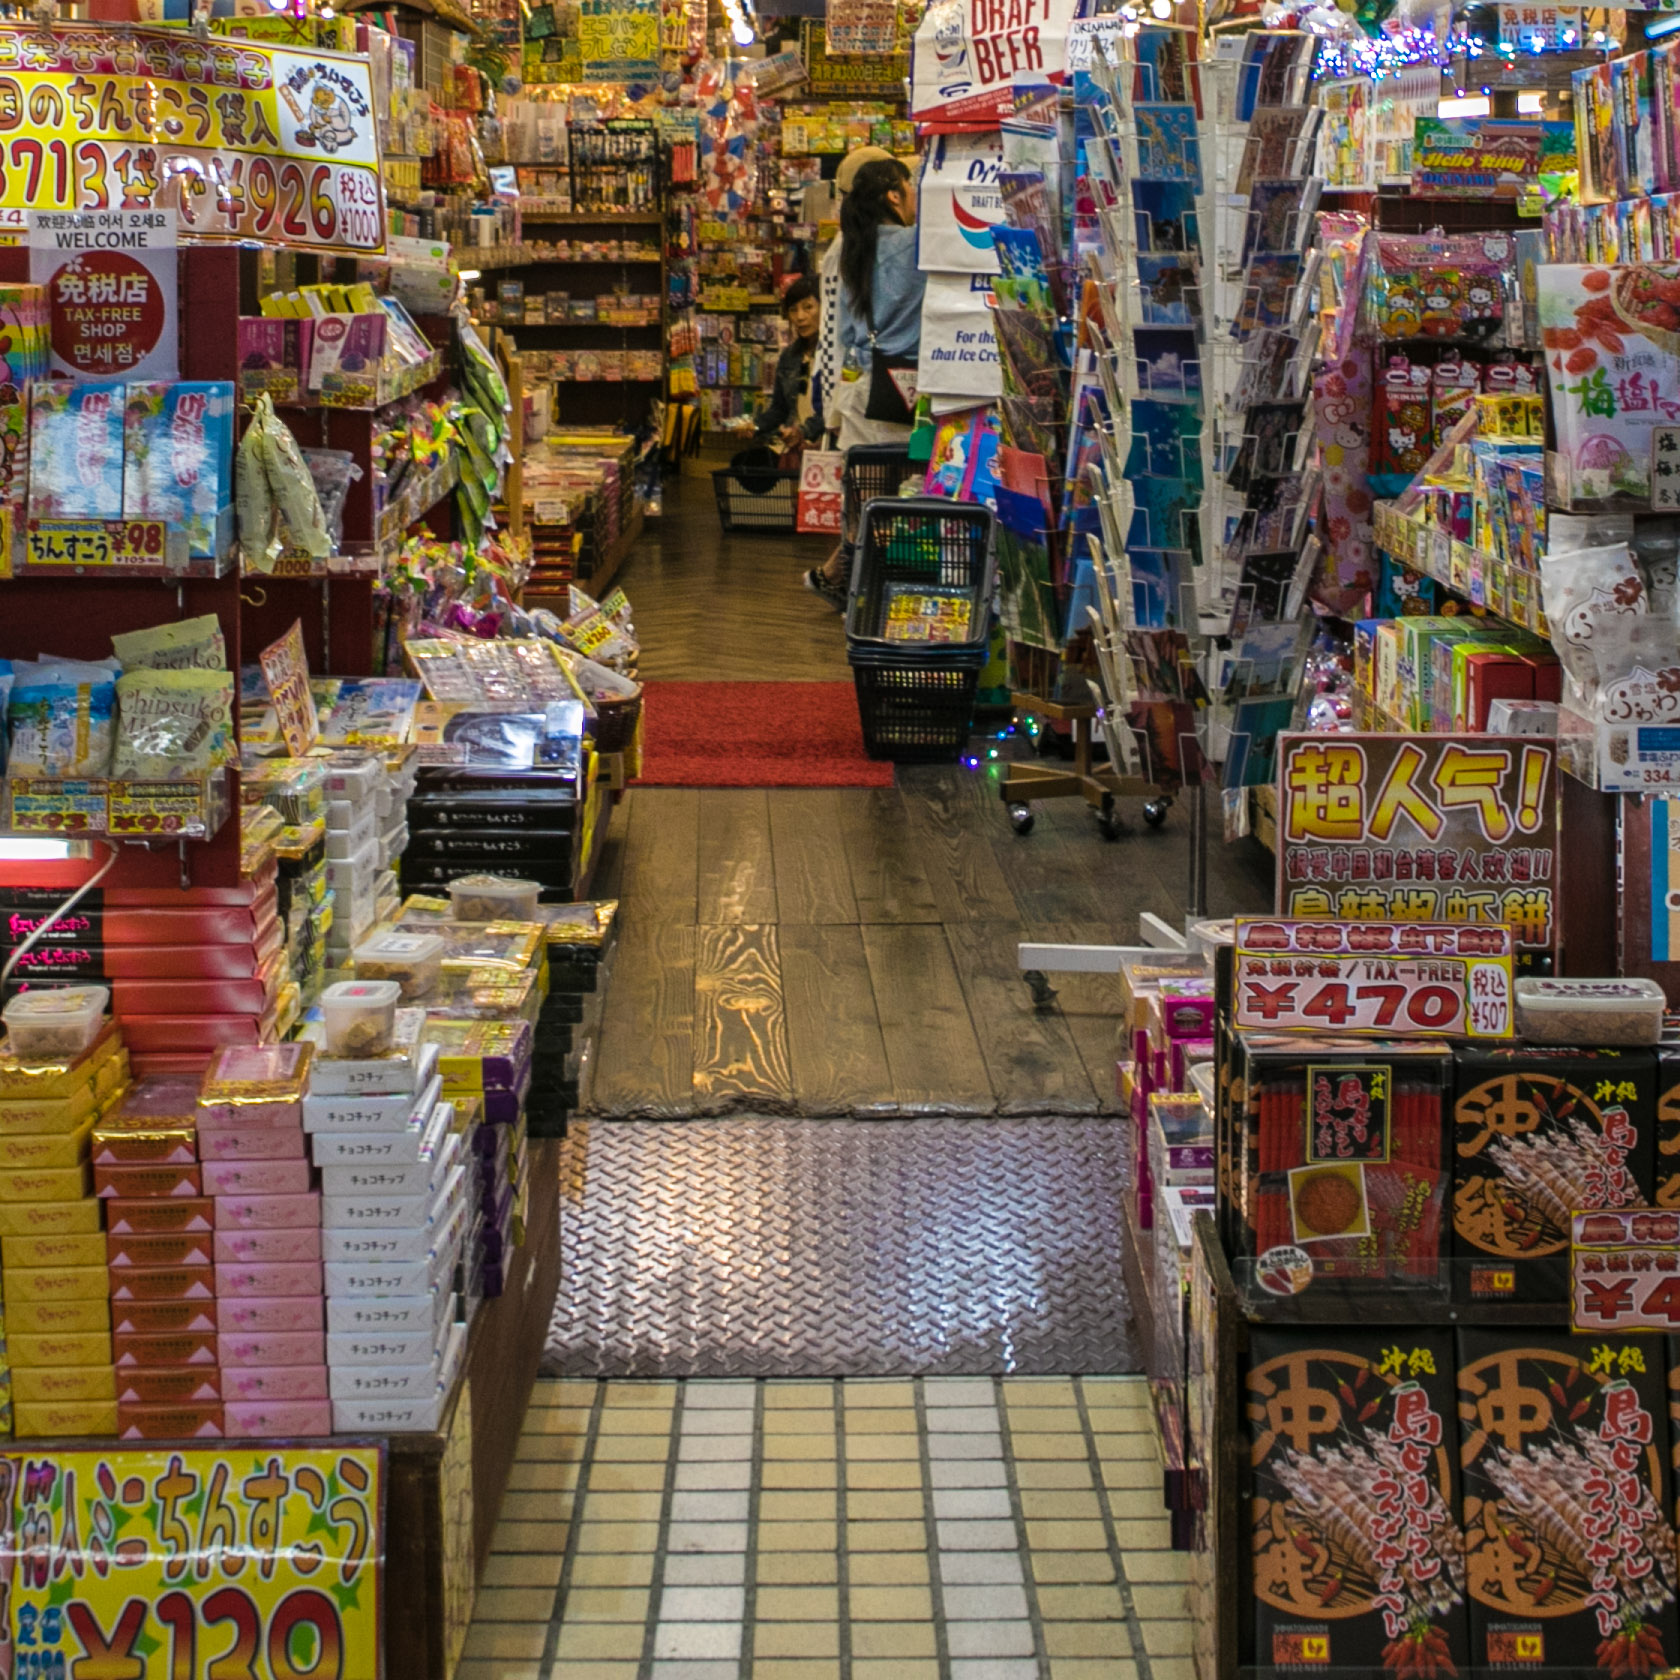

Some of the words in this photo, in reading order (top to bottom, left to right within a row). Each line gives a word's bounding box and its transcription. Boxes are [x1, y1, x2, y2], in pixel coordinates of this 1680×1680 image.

[1503, 6, 1557, 26] 免税店
[973, 25, 1044, 86] BEER
[1422, 153, 1475, 169] Hello
[338, 172, 376, 204] 税込
[98, 213, 124, 229] 어서
[130, 213, 167, 230] 오세요
[55, 230, 148, 250] WELCOME
[56, 271, 148, 306] 免税店
[64, 306, 142, 323] TAX-FREE
[80, 322, 127, 337] SHOP
[955, 329, 976, 345] For
[72, 343, 134, 366] 면세점
[931, 347, 960, 363] that
[961, 347, 978, 362] Ice
[29, 531, 108, 565] ちんすこう
[1642, 768, 1672, 784] 334
[1287, 743, 1551, 843] 超人气!
[1363, 961, 1465, 982] TAX-FREE
[1472, 968, 1505, 998] 税込
[1244, 982, 1460, 1026] ¥470
[1471, 1001, 1507, 1031] ¥507
[1594, 1080, 1639, 1102] 沖縄
[1380, 1344, 1438, 1377] 沖縄
[1589, 1344, 1647, 1377] 沖縄
